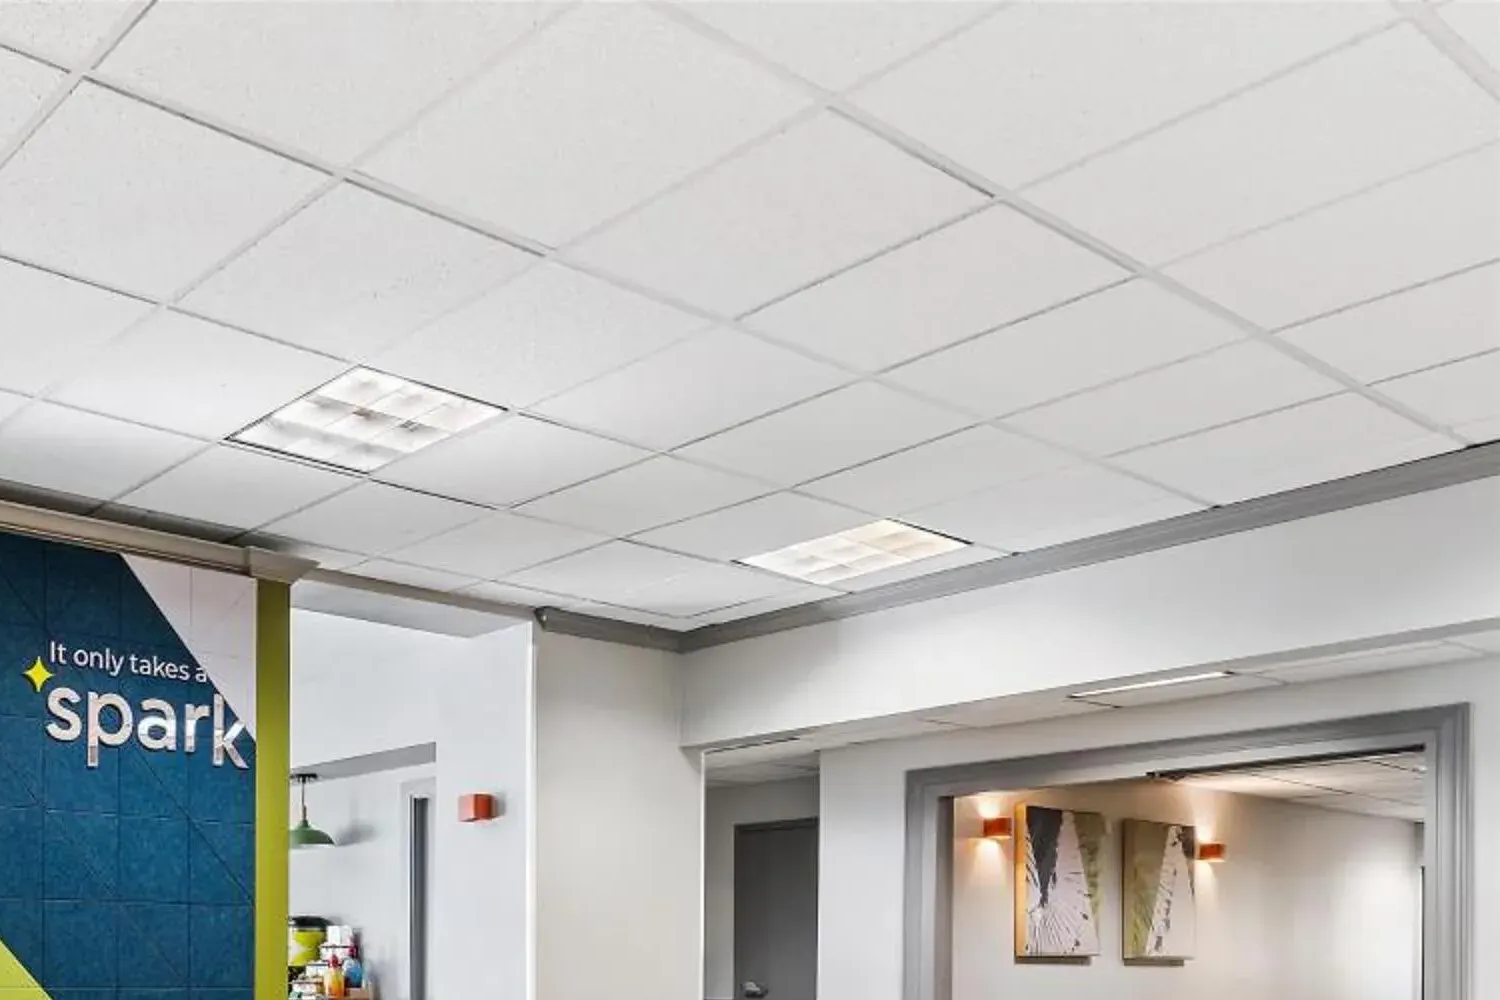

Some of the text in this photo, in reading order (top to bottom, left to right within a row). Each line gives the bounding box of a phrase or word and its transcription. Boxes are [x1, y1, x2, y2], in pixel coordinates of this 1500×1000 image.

[51, 641, 209, 682] It only takes a
[47, 687, 249, 768] spark
